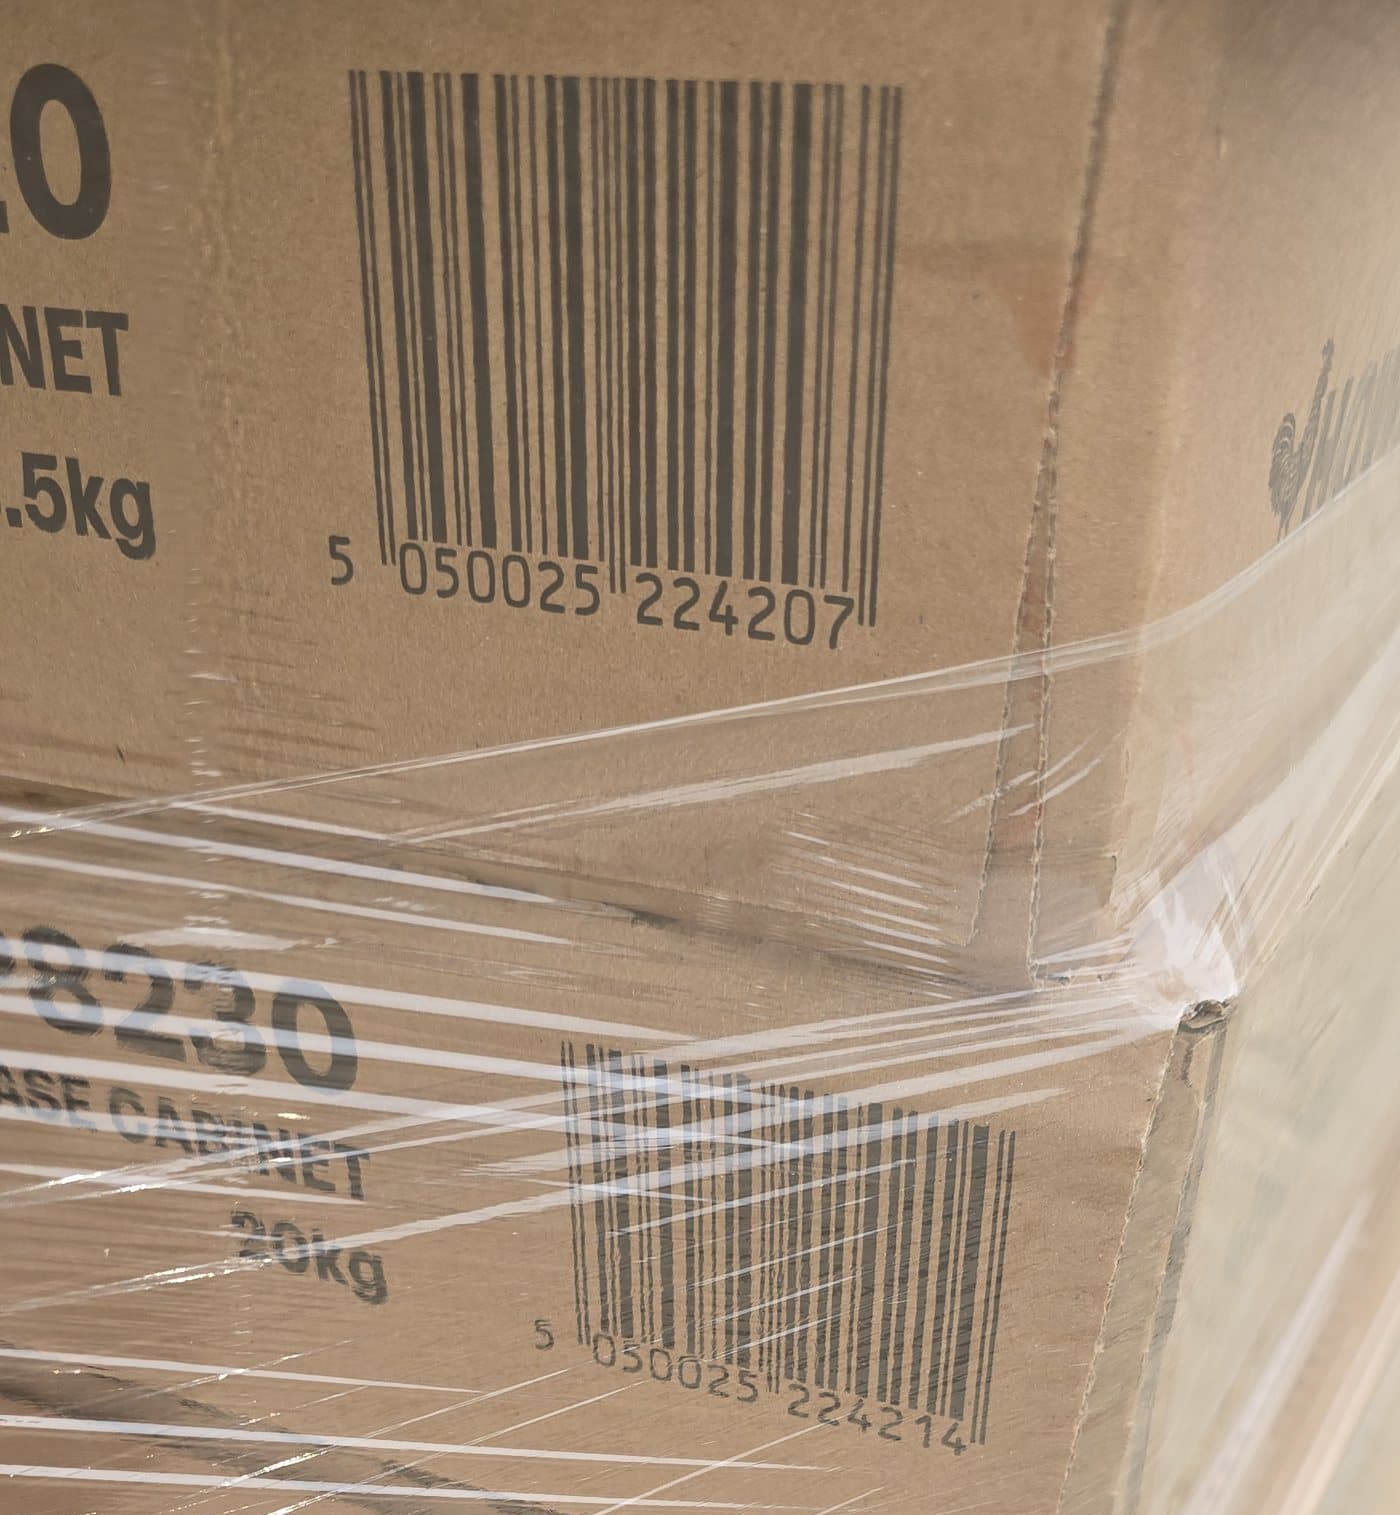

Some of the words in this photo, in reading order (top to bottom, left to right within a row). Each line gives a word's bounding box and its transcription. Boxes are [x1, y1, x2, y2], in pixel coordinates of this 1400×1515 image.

[0, 62, 112, 240] 0
[0, 304, 130, 396] NET
[328, 536, 354, 585] 5
[400, 542, 601, 616] 050025
[636, 572, 855, 649] 224207
[109, 1086, 370, 1201] CABINET
[231, 1210, 388, 1305] 20kg
[534, 1319, 555, 1351] 5
[592, 1333, 759, 1402] 050025
[786, 1382, 967, 1456] 224214
